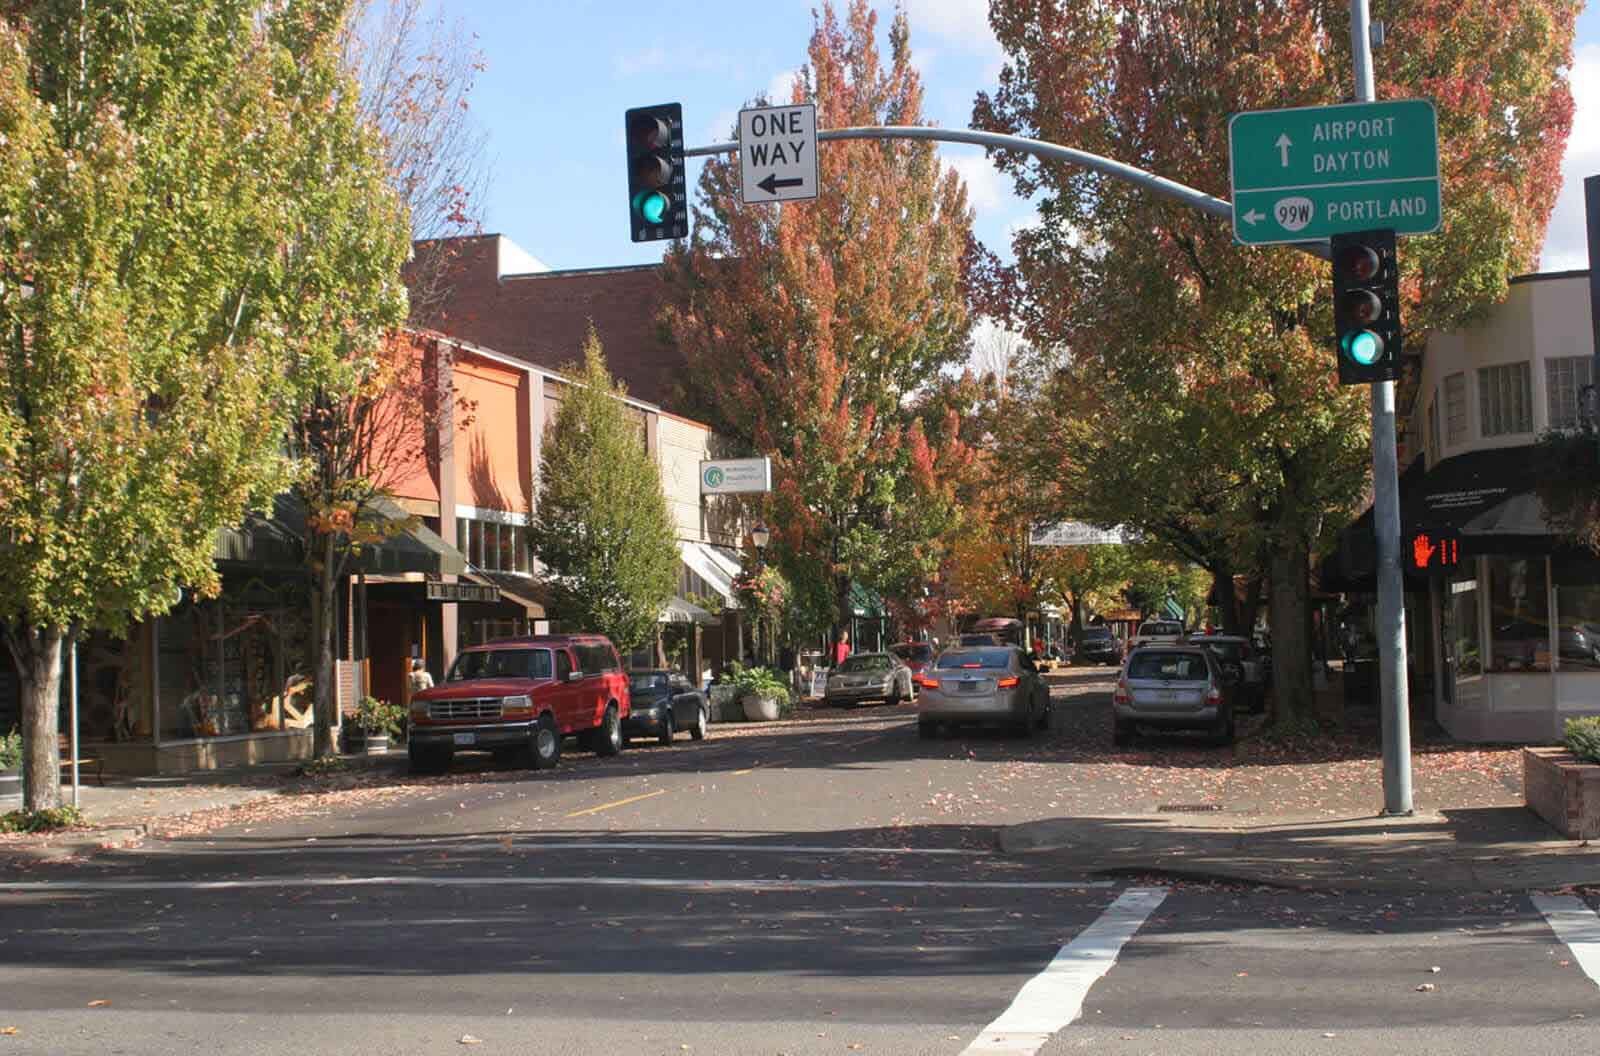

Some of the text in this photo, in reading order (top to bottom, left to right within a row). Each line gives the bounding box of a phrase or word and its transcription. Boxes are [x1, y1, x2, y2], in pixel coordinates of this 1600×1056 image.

[751, 111, 804, 137] ONE
[1312, 117, 1396, 142] AIRPORT
[750, 140, 806, 168] WAY
[1313, 149, 1390, 174] DAYTON
[1279, 196, 1428, 224] 99W PORTLAND
